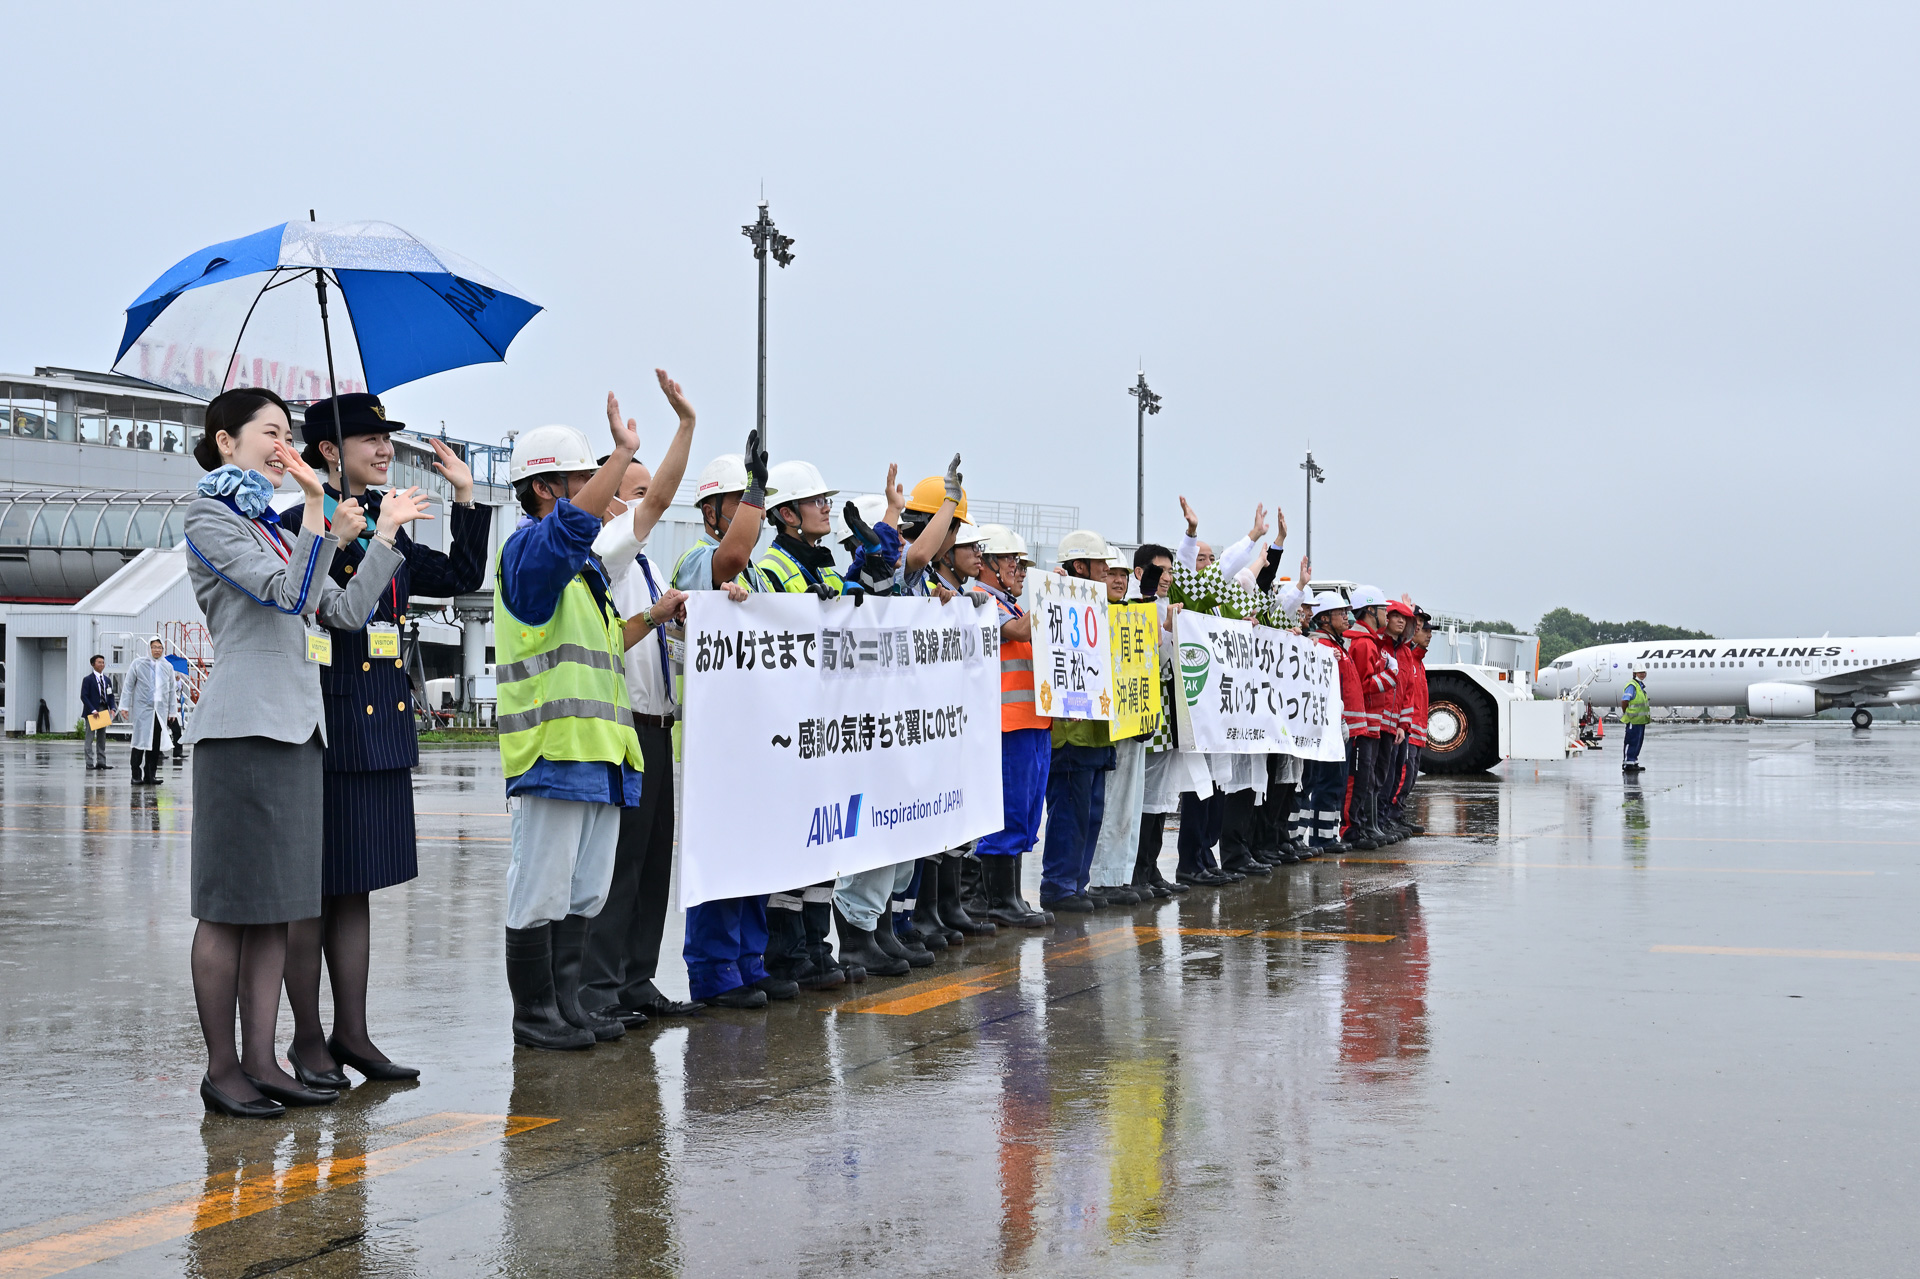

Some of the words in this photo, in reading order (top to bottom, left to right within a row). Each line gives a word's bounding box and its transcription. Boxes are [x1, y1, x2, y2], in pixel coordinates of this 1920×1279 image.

[312, 643, 328, 653] VISITOR
[1120, 625, 1144, 663] 周年
[1636, 648, 1718, 659] JAPAN
[1721, 646, 1842, 658] AIRLINES
[1116, 675, 1150, 716] 沖縄便
[1139, 714, 1154, 735] ANA
[806, 802, 843, 848] ANA
[871, 799, 932, 830] Inspiration
[933, 792, 942, 816] of
[943, 787, 964, 813] JAPAN
